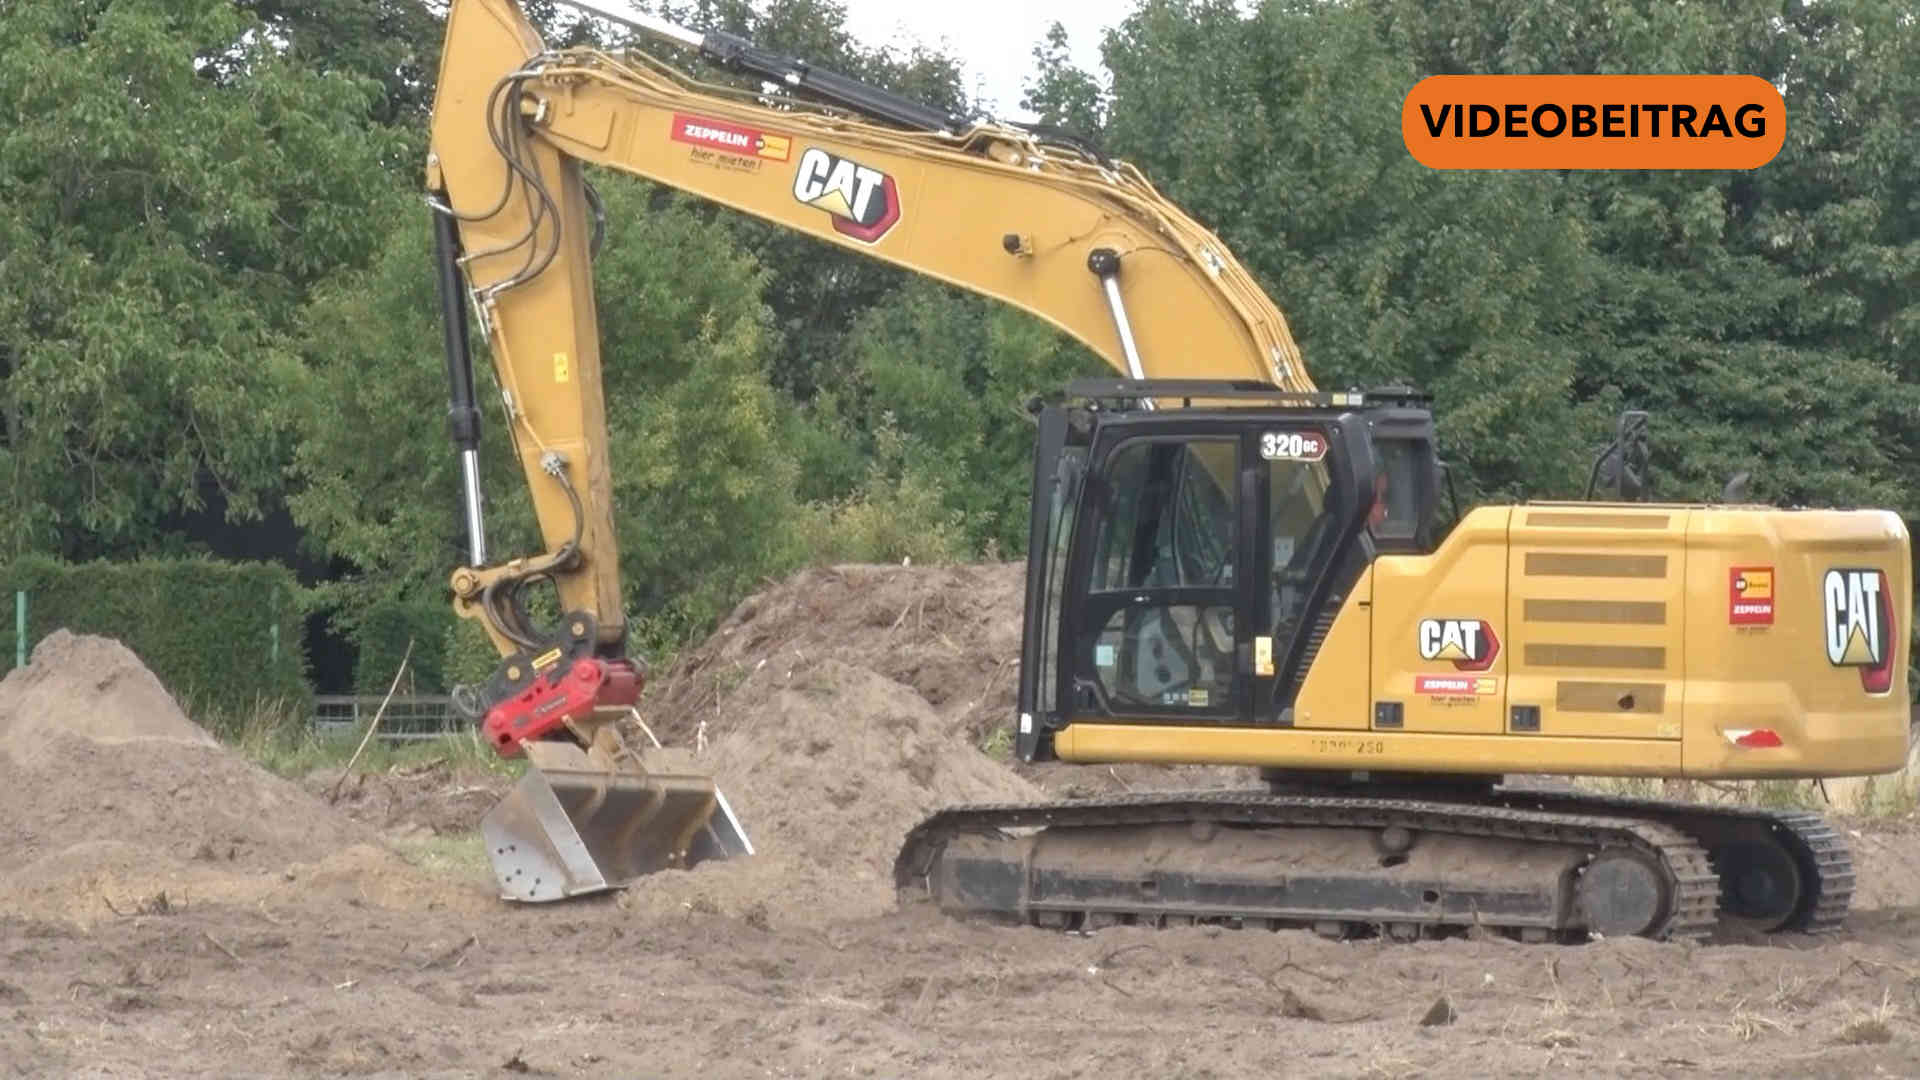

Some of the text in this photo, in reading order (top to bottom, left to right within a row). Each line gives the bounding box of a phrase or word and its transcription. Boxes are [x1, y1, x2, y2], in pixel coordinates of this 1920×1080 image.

[684, 123, 749, 147] ZEPPELIN
[794, 147, 885, 223] CAT
[1419, 619, 1481, 660] CAT
[1825, 570, 1881, 665] CAT
